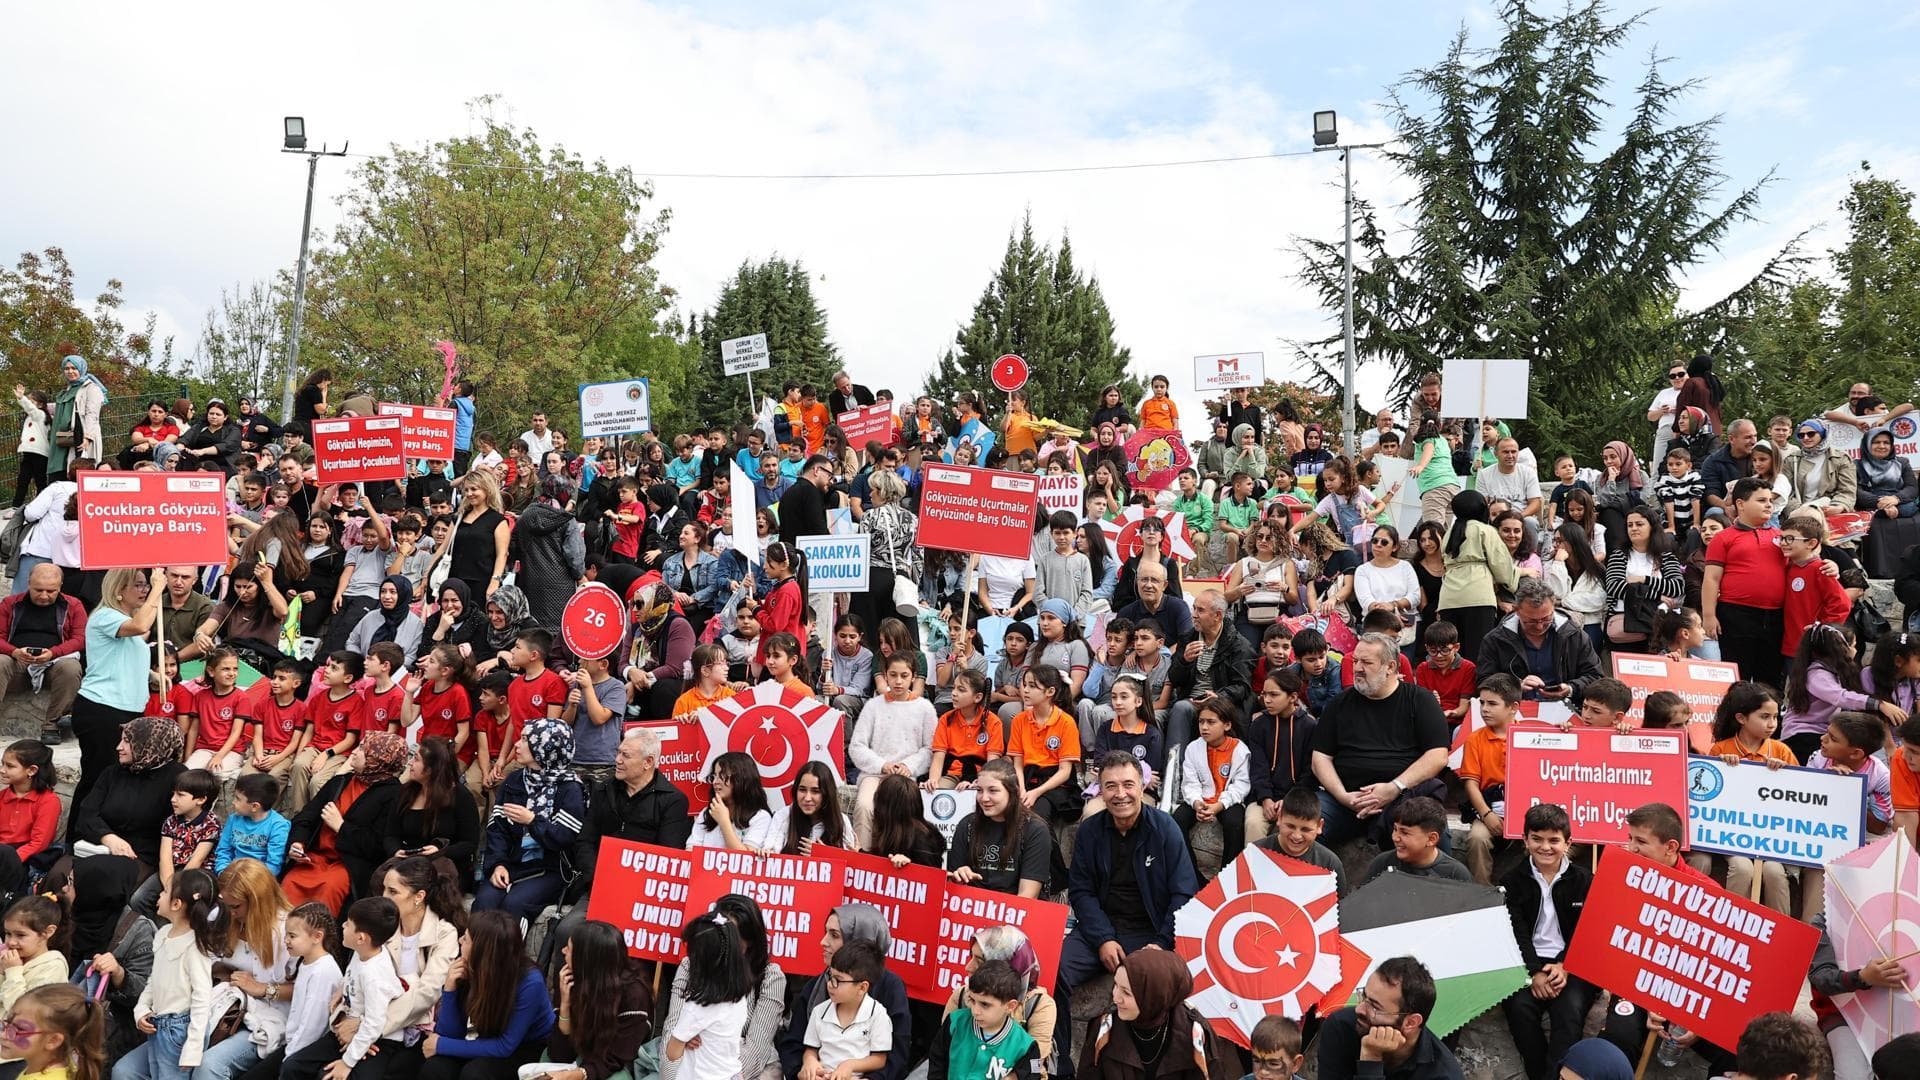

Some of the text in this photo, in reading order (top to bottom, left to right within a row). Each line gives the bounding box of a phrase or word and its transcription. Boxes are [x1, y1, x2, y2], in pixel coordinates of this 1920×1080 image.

[1006, 365, 1013, 375] 3
[1206, 375, 1251, 383] MENDERES
[417, 426, 449, 438] Gökyüzü,
[327, 436, 393, 452] Gökyüzü Hepimizin,
[422, 440, 443, 452] Barış.
[1894, 442, 1917, 455] BAK
[322, 458, 361, 472] Uçurtmalar
[85, 502, 220, 518] Çocuklara Gökyüzü,
[926, 491, 1031, 515] Gökyüzünde Uçurtmalar,
[103, 520, 206, 535] Dünyaya Barış.
[925, 506, 1028, 528] Yeryüzünde Barış Olsun.
[805, 544, 860, 560] SAKARYA
[808, 564, 861, 579] LKOKULU
[584, 608, 606, 628] 26
[658, 751, 693, 764] ocuklar
[1540, 759, 1652, 786] Uçurtmalarımız
[1758, 787, 1828, 806] ÇORUM
[1572, 795, 1599, 828] İçin
[1689, 805, 1848, 840] DUMLUPINAR
[1697, 825, 1823, 859] İLKOKULU
[620, 848, 691, 879] UÇURTM
[703, 850, 832, 883] UÇURTMALAR
[844, 866, 928, 905] CUKLARIN
[631, 902, 683, 928] UMUD
[1625, 865, 1776, 945] GÖKYÜZÜNDE
[1638, 903, 1752, 972] UÇURTMA,
[1609, 924, 1751, 1004] KALBİMİZDE
[1634, 968, 1712, 1020] UMUT!
